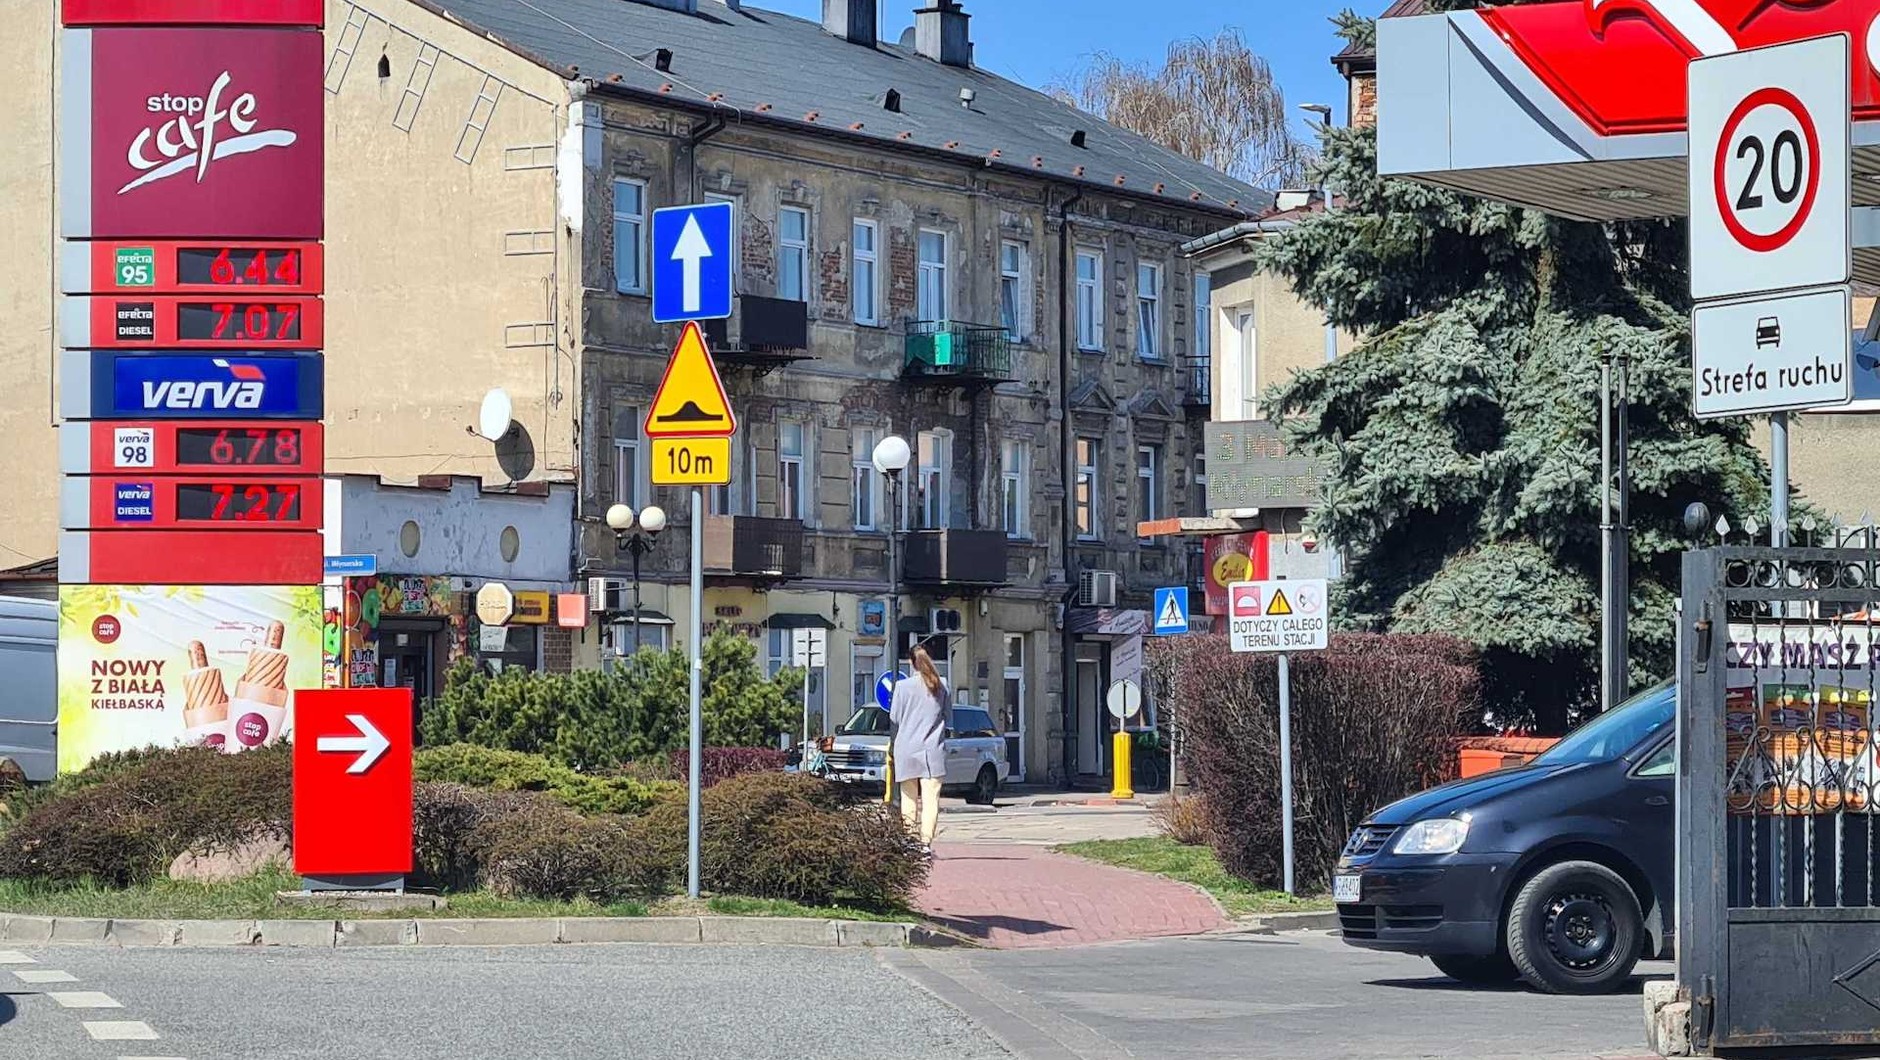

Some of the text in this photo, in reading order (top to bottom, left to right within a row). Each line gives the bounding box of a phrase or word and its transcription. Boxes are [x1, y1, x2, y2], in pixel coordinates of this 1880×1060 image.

[147, 93, 204, 116] stop
[127, 70, 258, 183] cafe
[1736, 129, 1802, 211] 20
[121, 266, 148, 284] 95
[210, 250, 299, 284] 6.44
[118, 326, 153, 335] DIESEL
[211, 304, 299, 339] 7.07
[1701, 356, 1843, 396] Strefa ruchu
[142, 381, 265, 409] verva
[118, 434, 150, 444] verva
[210, 430, 299, 464] 6.78
[1214, 431, 1234, 461] 3
[122, 447, 147, 464] 98
[117, 489, 151, 499] verva
[211, 484, 299, 520] 7.27
[117, 506, 151, 515] DIESEL
[1233, 620, 1279, 633] DOTYCZY
[1242, 632, 1315, 648] TERENU STACJI
[1781, 642, 1861, 669] MASZ
[91, 660, 167, 676] NOWY
[91, 679, 165, 698] Z BIAŁĄ
[91, 698, 165, 711] KIEŁBASKĄ
